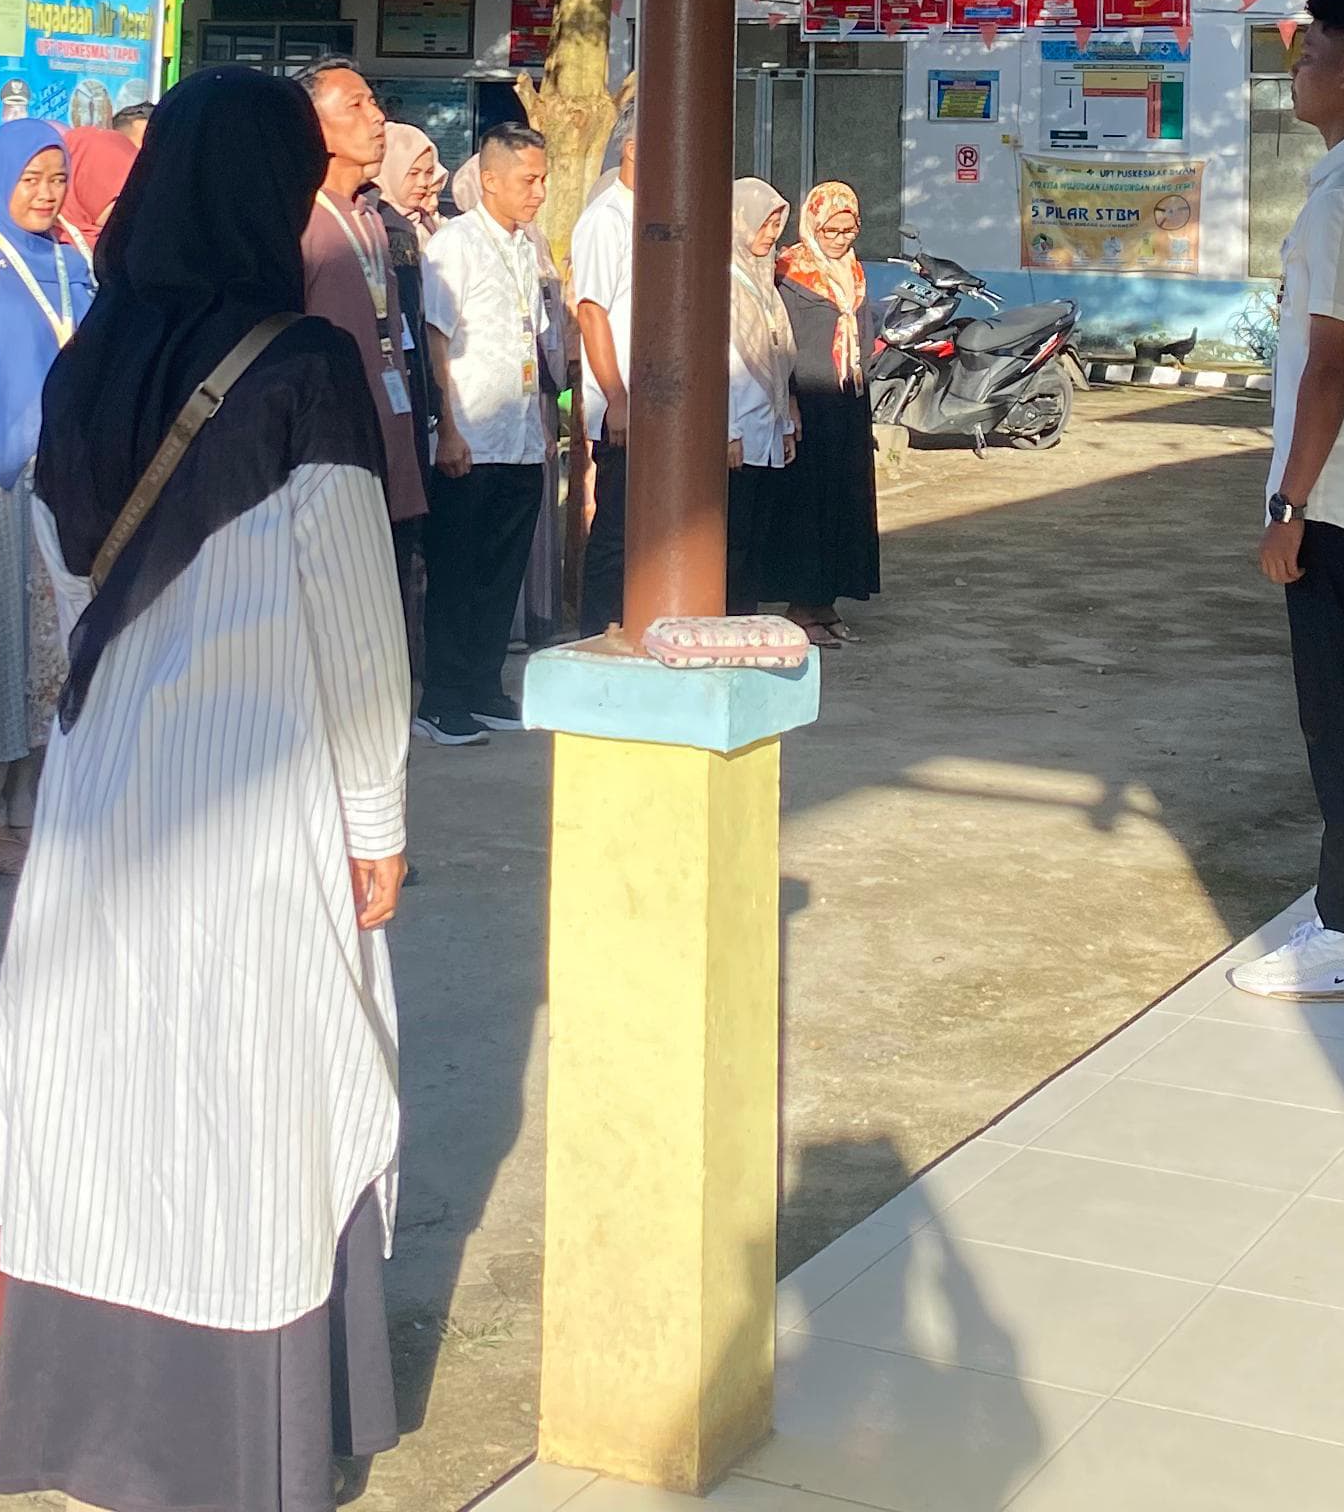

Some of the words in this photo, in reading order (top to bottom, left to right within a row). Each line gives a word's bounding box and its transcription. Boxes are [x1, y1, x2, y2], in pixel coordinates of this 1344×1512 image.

[57, 41, 111, 59] PUSKESMAS
[1031, 206, 1039, 218] 5
[1045, 206, 1089, 221] PILAR
[1095, 208, 1140, 221] STBM
